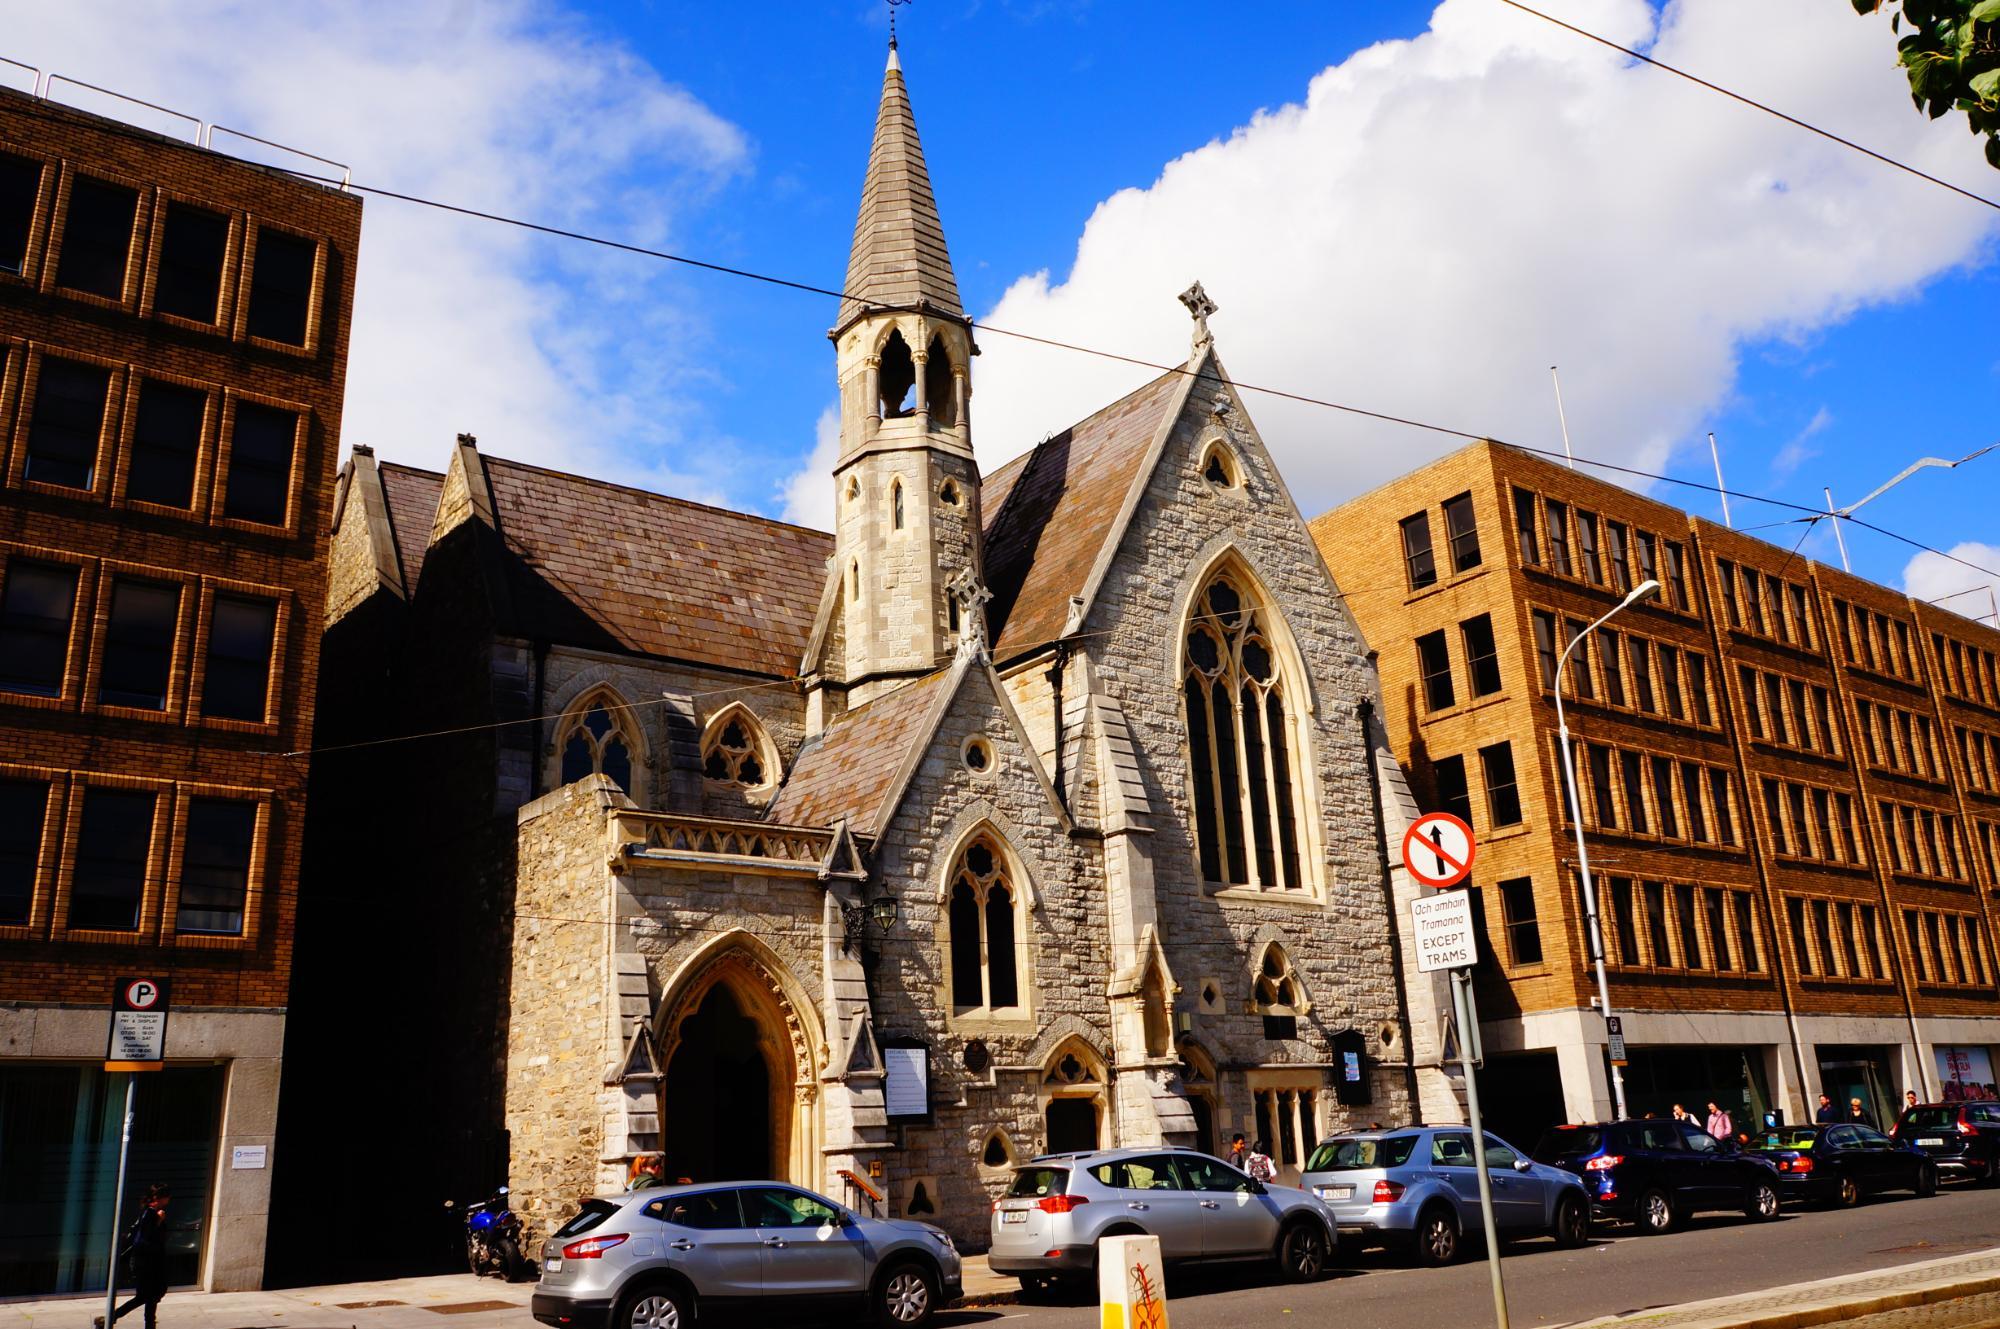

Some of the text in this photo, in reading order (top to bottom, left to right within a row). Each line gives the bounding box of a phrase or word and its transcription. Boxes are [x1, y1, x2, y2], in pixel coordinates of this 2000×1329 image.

[1421, 915, 1464, 931] Tramanna
[1423, 932, 1465, 950] EXCEPT
[1426, 948, 1467, 966] TRAMS
[136, 984, 151, 1003] P
